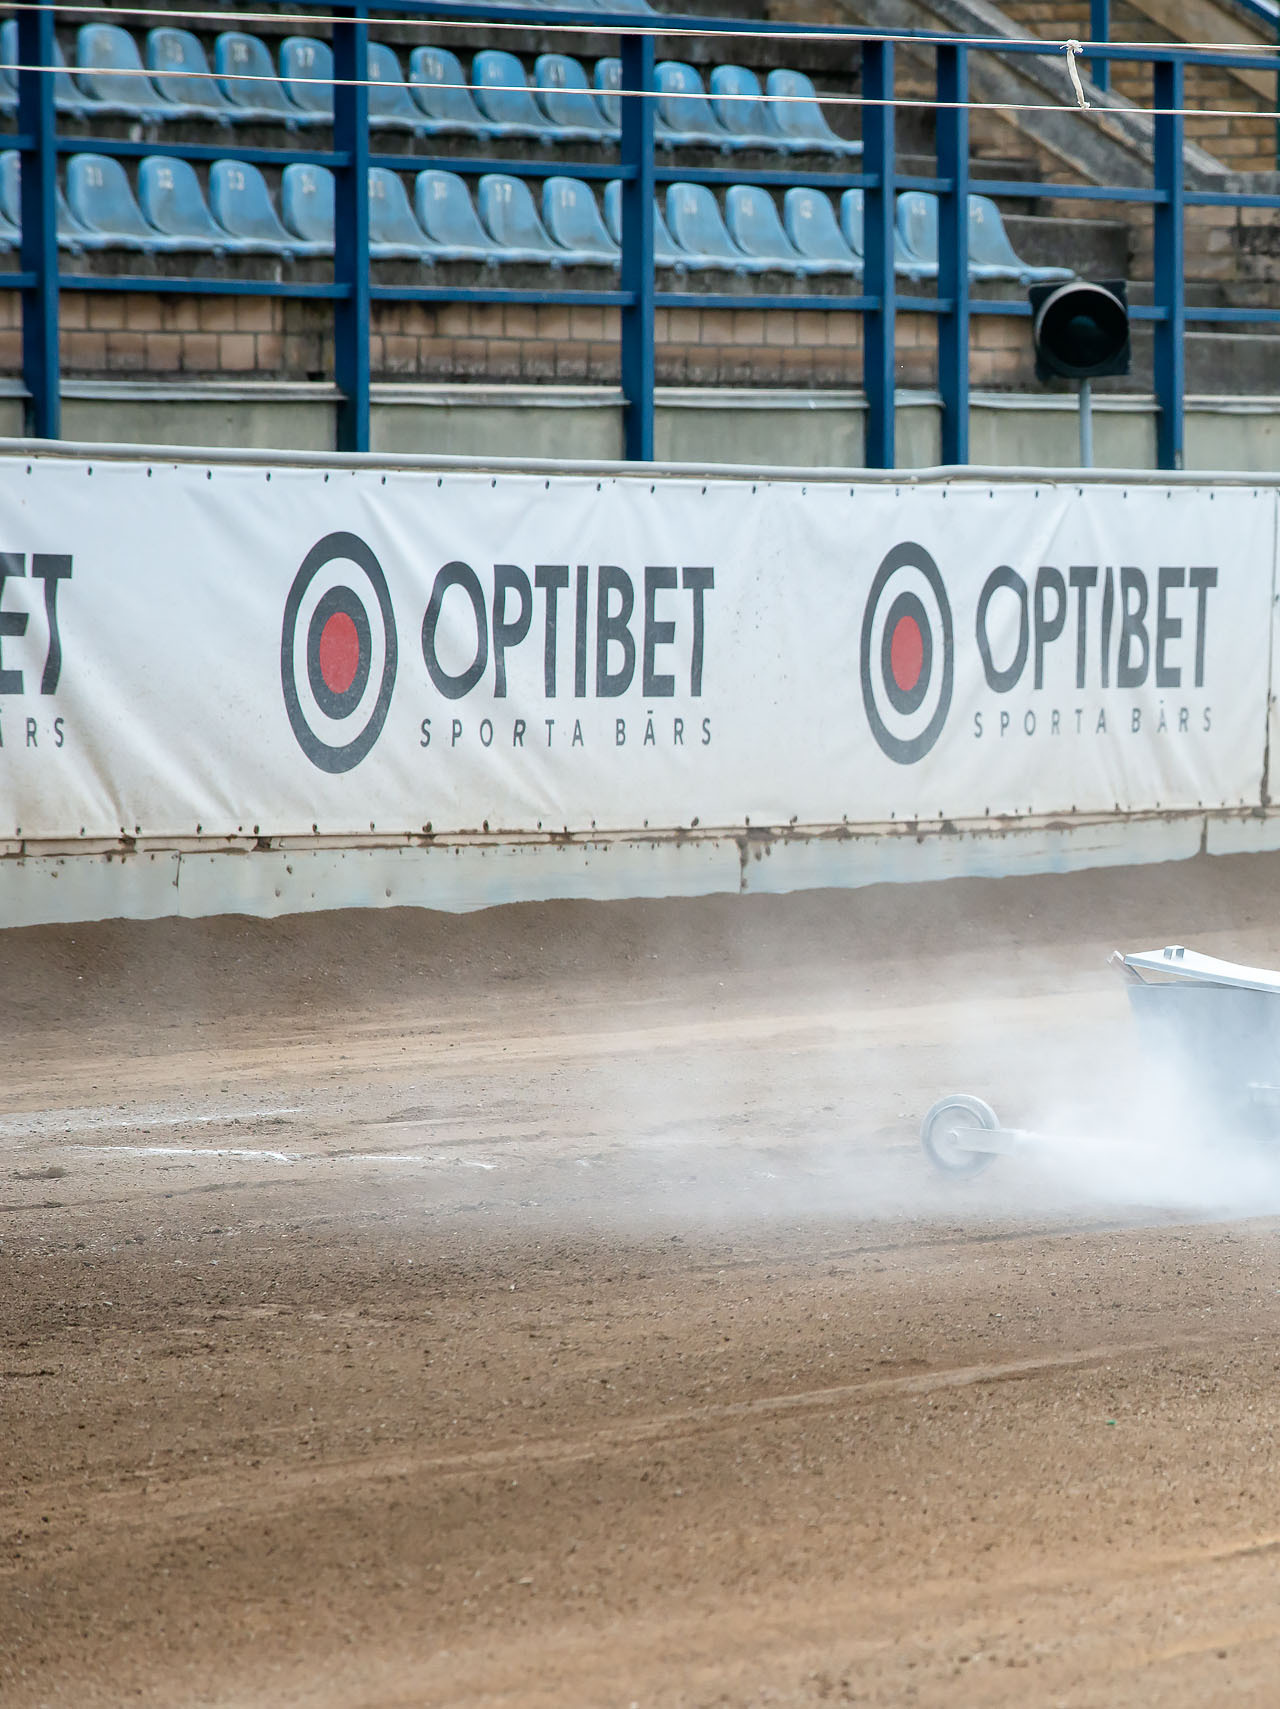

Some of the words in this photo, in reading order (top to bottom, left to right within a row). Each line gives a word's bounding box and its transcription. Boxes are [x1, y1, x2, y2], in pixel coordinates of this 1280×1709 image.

[421, 561, 714, 699] OPTIBET
[975, 565, 1217, 693] OPTIBET
[420, 718, 584, 748] SPORTA
[615, 710, 711, 746] BĀRS
[974, 707, 1107, 738] SPORTA
